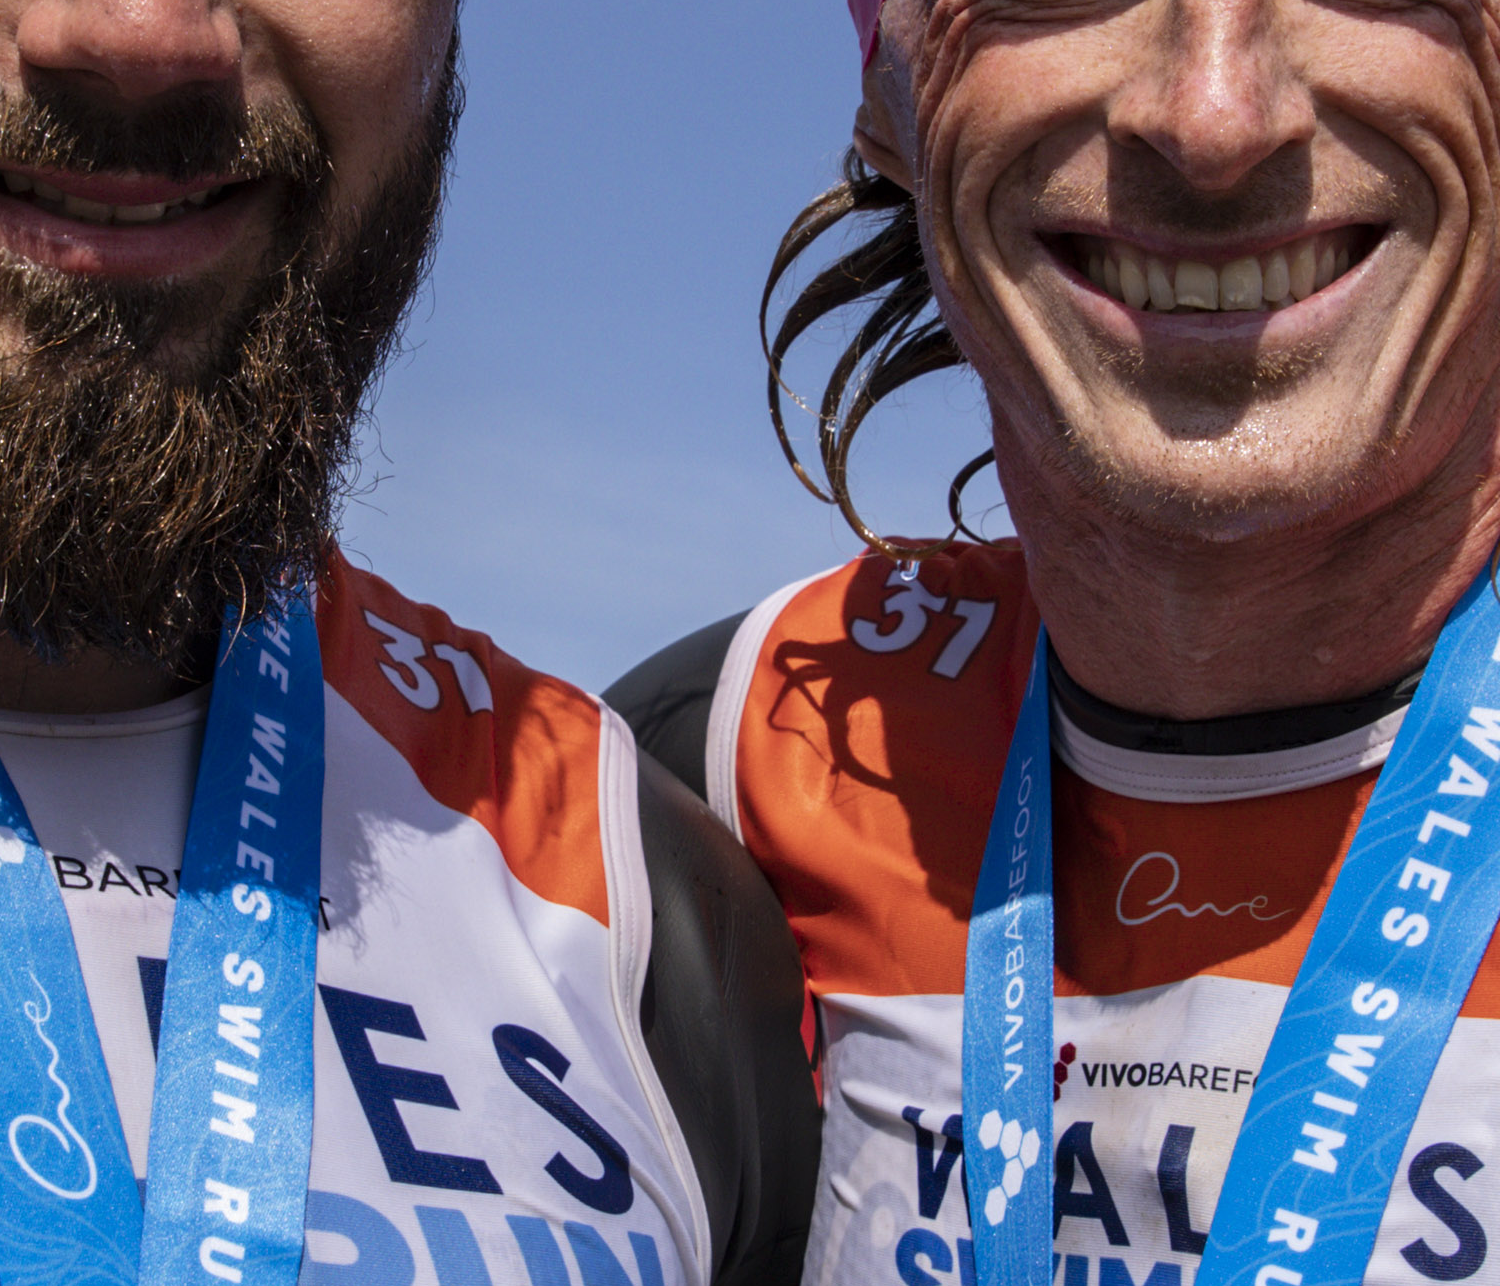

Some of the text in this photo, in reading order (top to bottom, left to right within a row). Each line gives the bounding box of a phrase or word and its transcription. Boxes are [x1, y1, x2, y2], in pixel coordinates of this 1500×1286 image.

[363, 609, 494, 714] 31
[851, 568, 996, 679] 31
[231, 713, 286, 921] WALES
[1003, 756, 1033, 1091] VIVOBAREFOOT
[210, 952, 266, 1145] SWIM
[1082, 1062, 1259, 1094] VIVOBAREF
[1293, 981, 1400, 1174] SWIM
